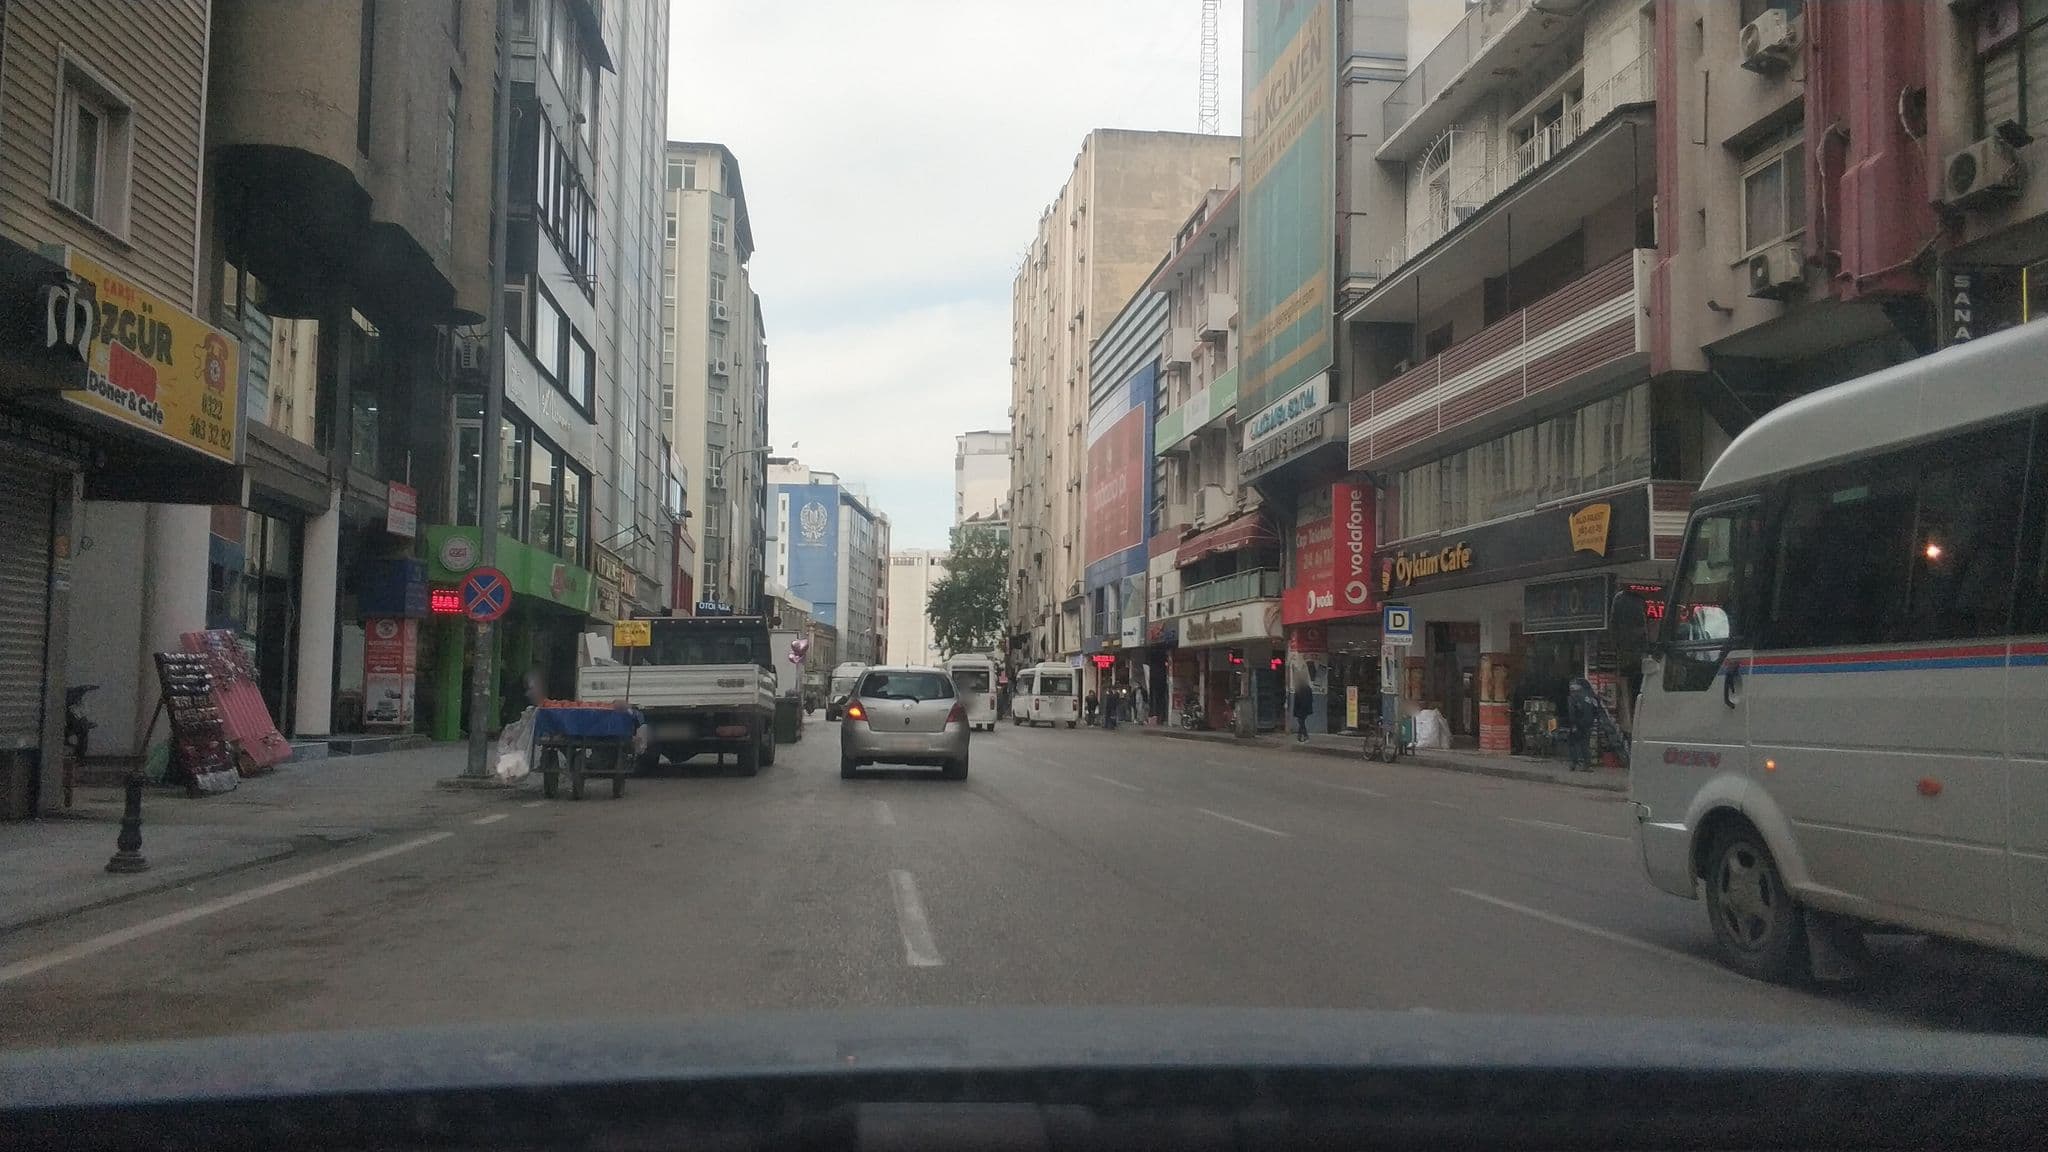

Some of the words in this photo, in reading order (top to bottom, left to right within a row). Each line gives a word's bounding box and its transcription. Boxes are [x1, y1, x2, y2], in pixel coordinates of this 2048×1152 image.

[92, 296, 174, 367] ZGÜR
[88, 368, 127, 408] Döner
[127, 390, 137, 412] &
[138, 395, 165, 425] Cafe
[201, 393, 223, 421] 0322
[189, 414, 207, 440] 363
[207, 422, 220, 447] 32
[220, 427, 233, 451] 82
[1347, 490, 1364, 577] vodafone
[1396, 549, 1440, 587] Öyküm
[1440, 540, 1472, 573] Cafe
[1392, 612, 1405, 628] D
